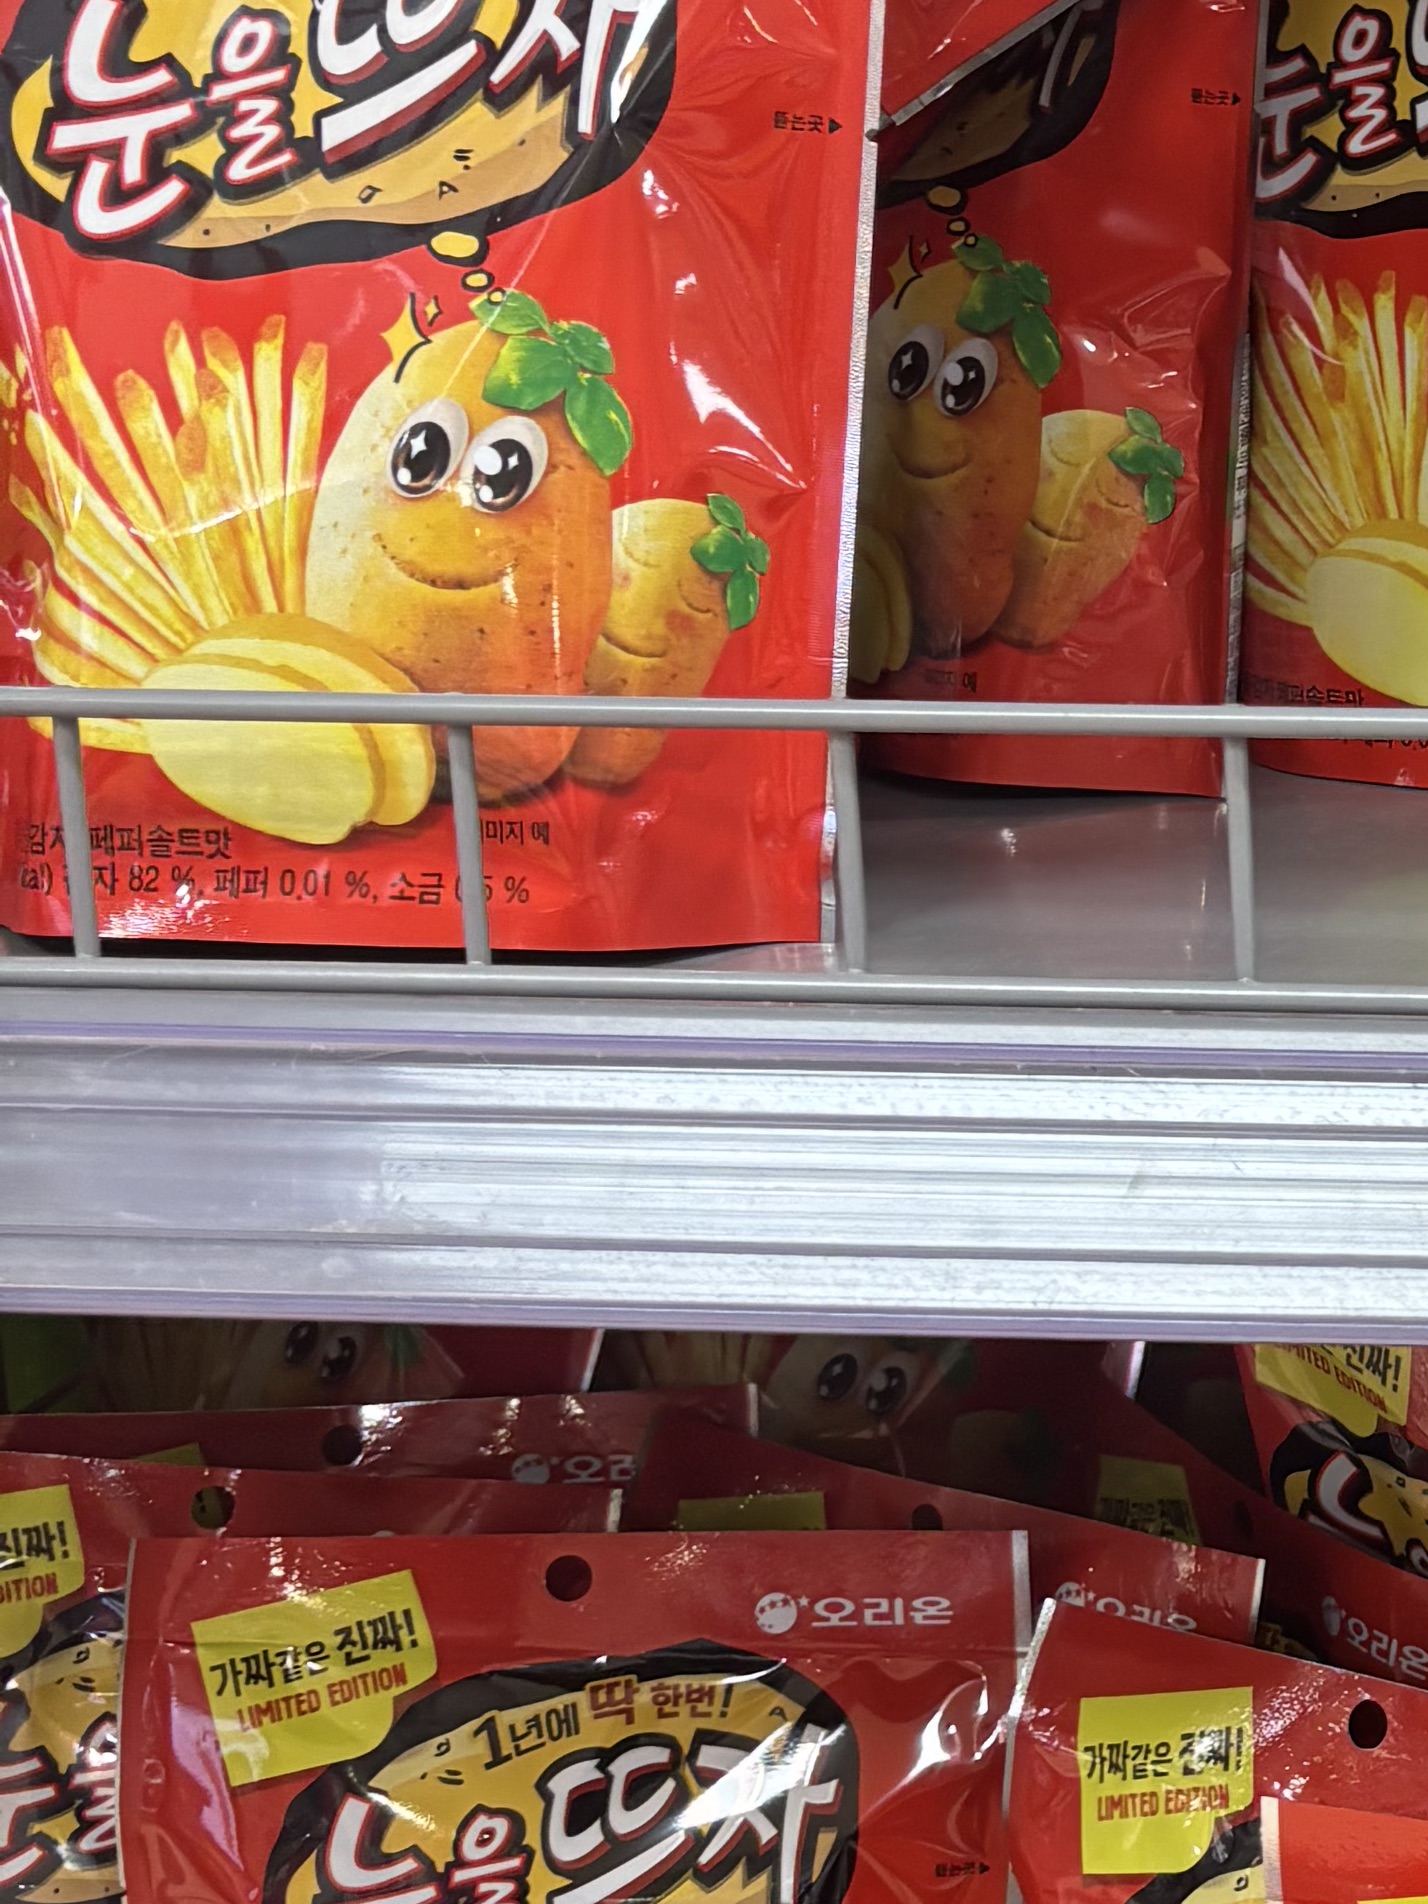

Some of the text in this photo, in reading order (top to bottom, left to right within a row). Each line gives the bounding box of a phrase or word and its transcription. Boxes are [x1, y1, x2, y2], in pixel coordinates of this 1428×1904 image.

[127, 866, 530, 904] 82 페퍼 0.01 소금 %
[812, 1595, 954, 1628] 오리온
[209, 1607, 417, 1700] 가짜같은 진짜!
[238, 1661, 409, 1733] LIMITED EDITION
[472, 1680, 734, 1771] 1년에 딱 한번!
[1083, 1724, 1244, 1785] 가짜같은 진짜!
[1096, 1784, 1230, 1822] LIMITED EDITION
